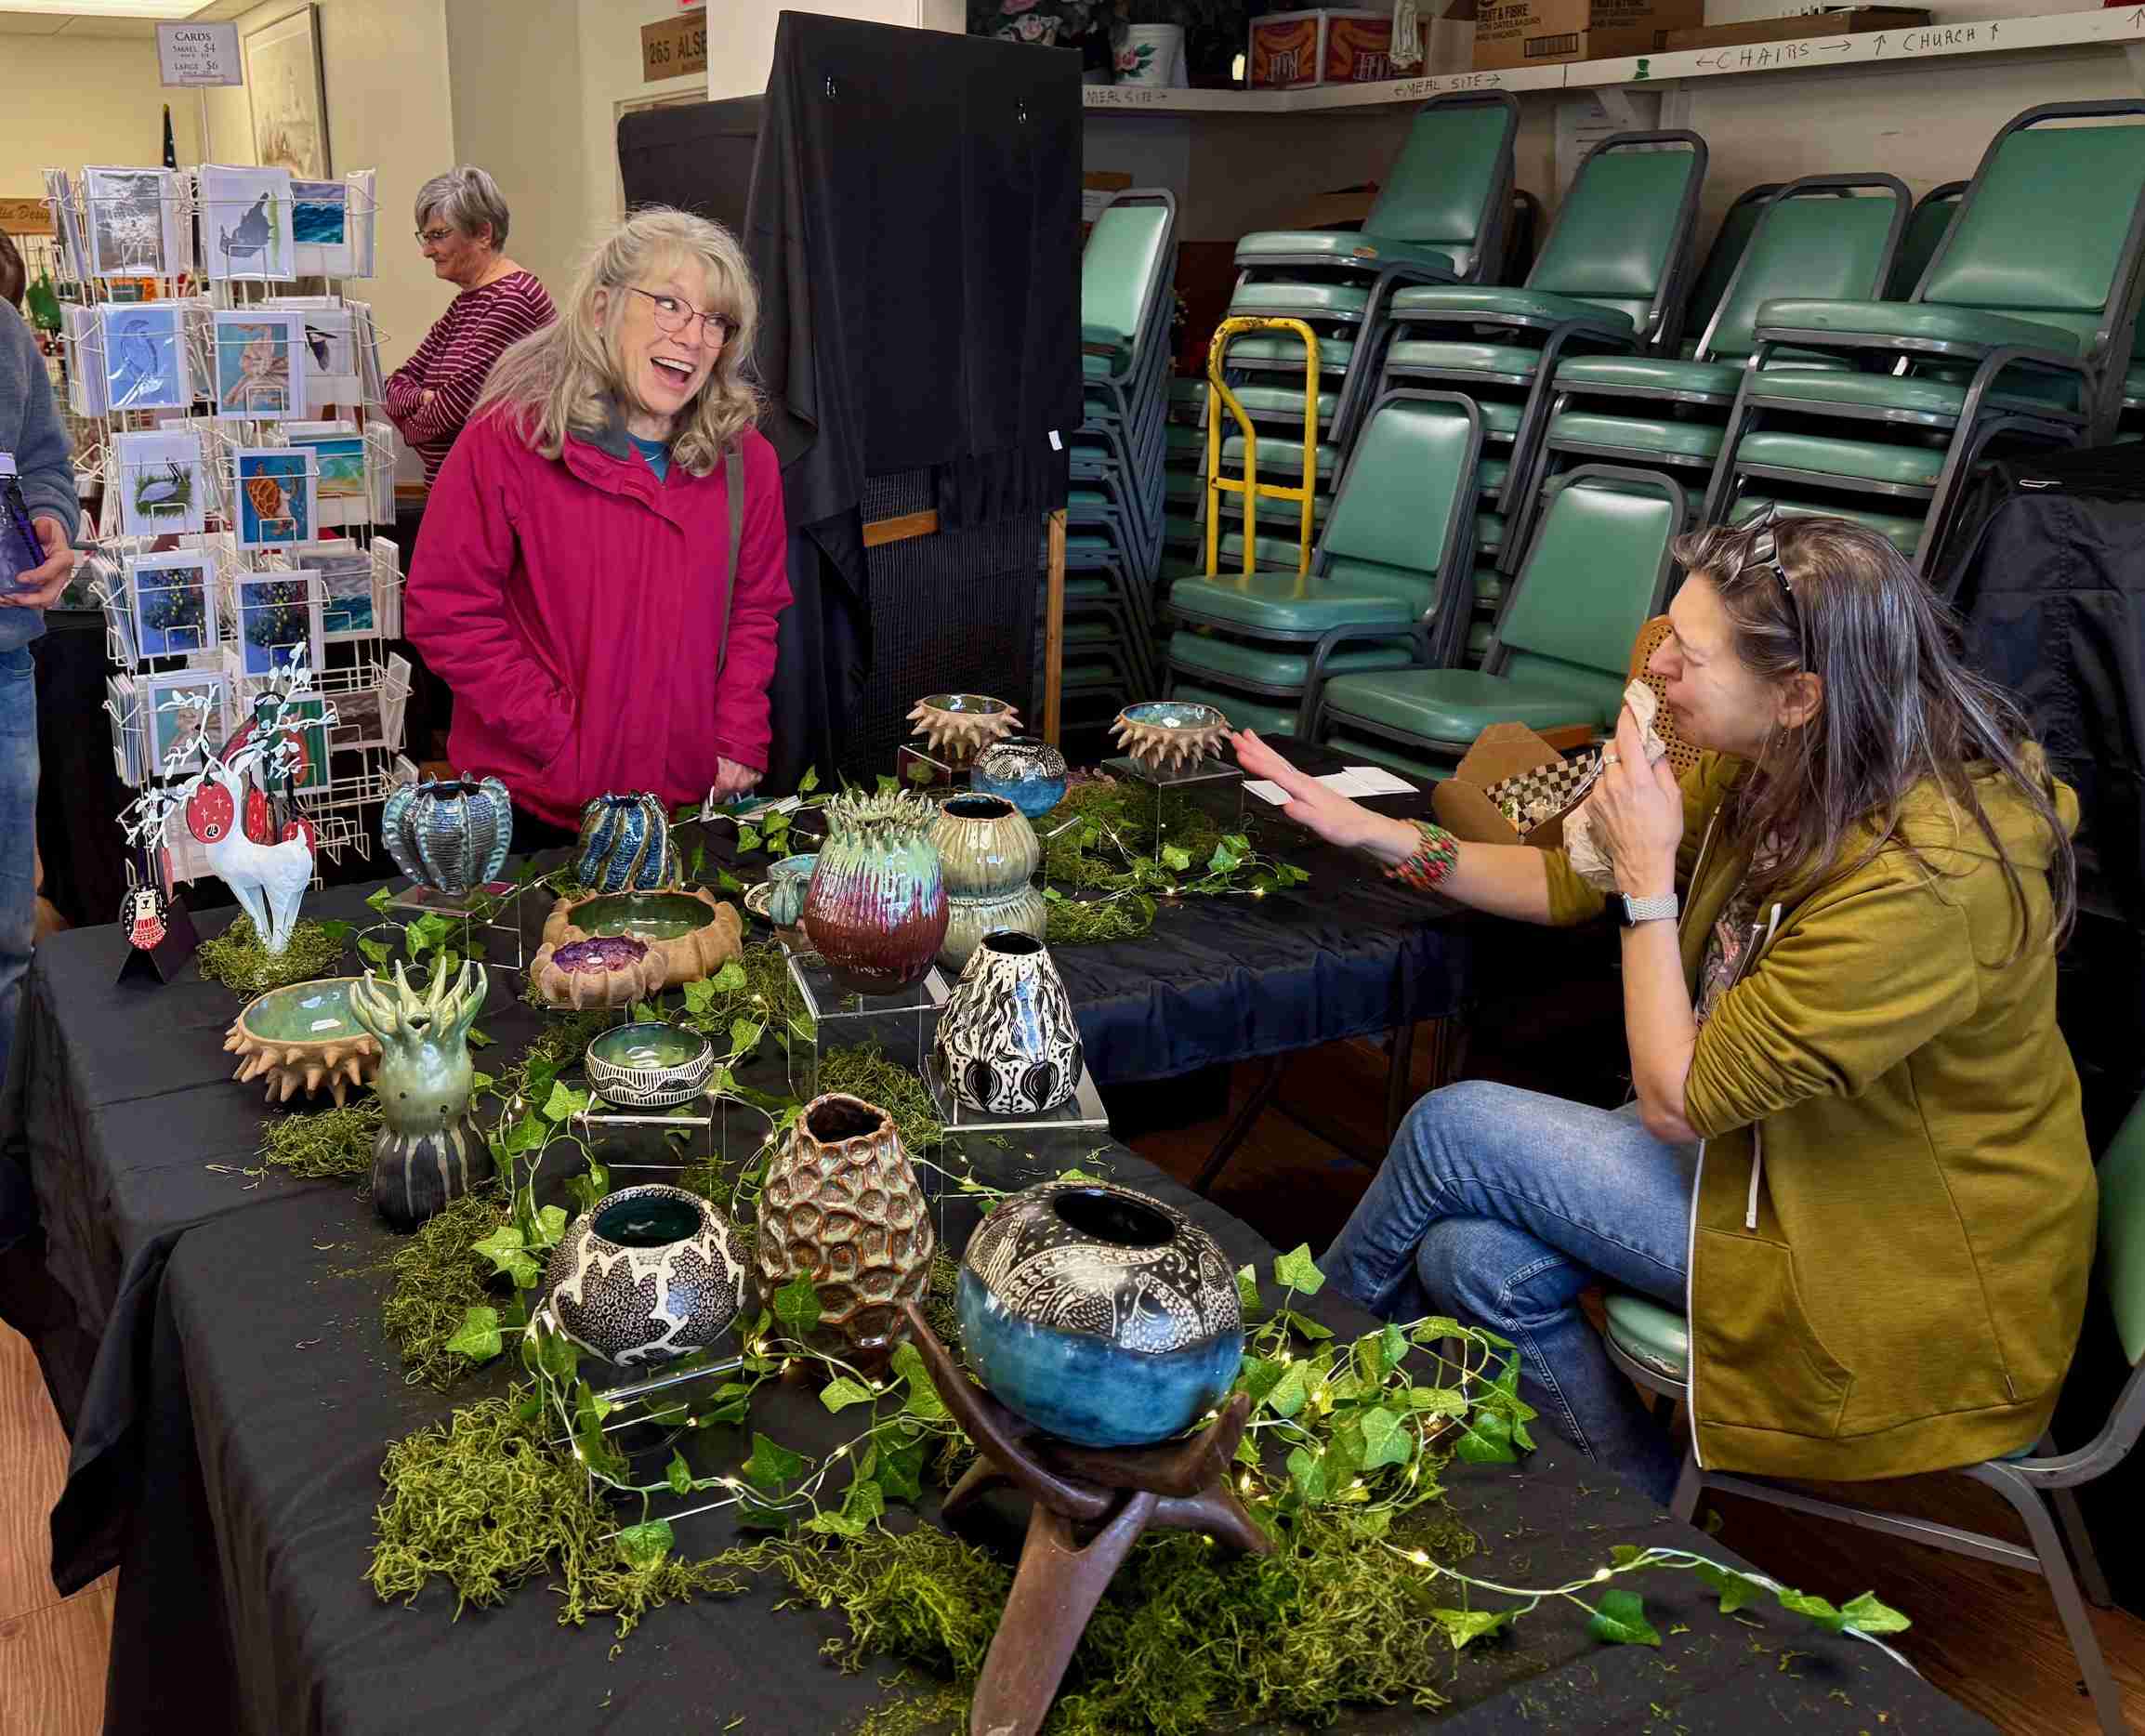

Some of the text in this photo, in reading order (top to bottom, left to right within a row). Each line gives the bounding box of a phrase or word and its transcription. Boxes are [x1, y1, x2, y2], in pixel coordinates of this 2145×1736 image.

[175, 32, 212, 42] CARDS
[204, 43, 217, 53] $4
[1902, 29, 1977, 51] CHURCH
[650, 40, 670, 64] 265
[1717, 43, 1809, 69] CHAIRS
[206, 60, 218, 71] $6
[1403, 73, 1481, 98] MEAL SITE
